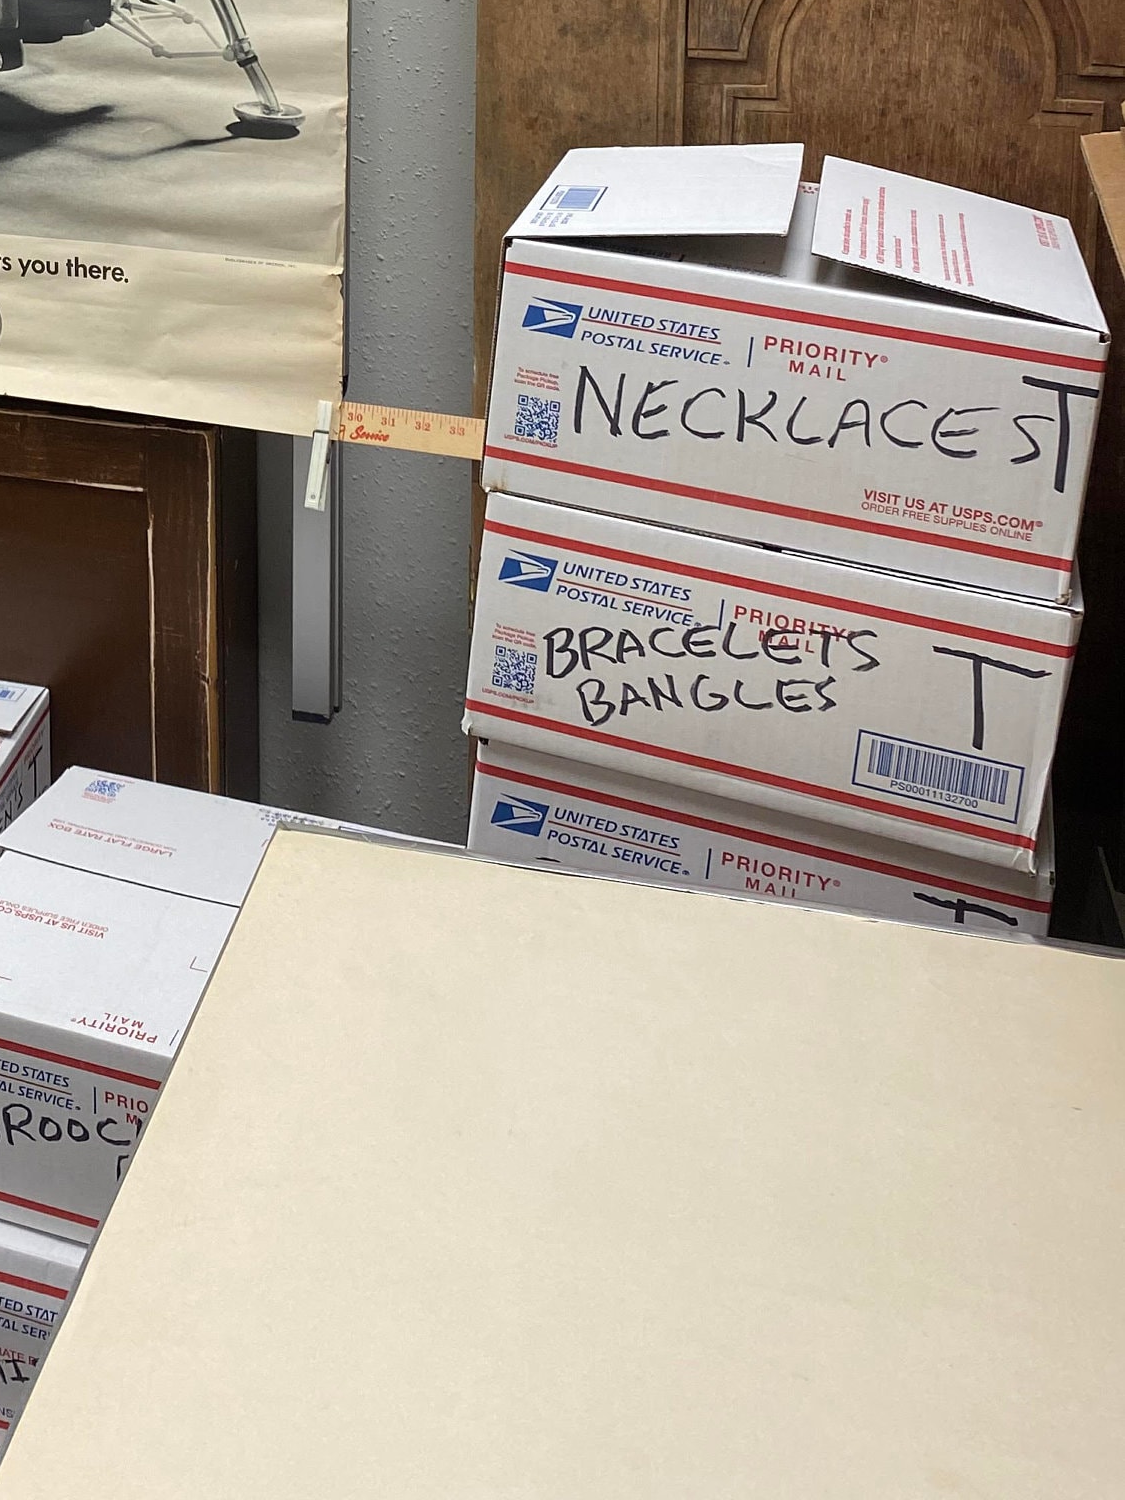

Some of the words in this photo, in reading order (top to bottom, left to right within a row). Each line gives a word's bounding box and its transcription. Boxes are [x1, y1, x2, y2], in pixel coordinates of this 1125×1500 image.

[18, 258, 60, 277] you
[65, 257, 130, 284] there.
[588, 306, 654, 330] UNITED
[658, 318, 721, 340] STATES
[581, 330, 644, 353] POSTAL
[788, 360, 848, 382] MAIL
[347, 411, 363, 423] 30
[381, 417, 395, 427] 31
[415, 421, 431, 431] 32
[449, 426, 465, 436] 33
[574, 366, 1055, 465] NECKLACES
[1022, 376, 1100, 494] T
[864, 489, 901, 506] VISIT
[904, 495, 926, 511] US
[929, 501, 948, 515] AT
[861, 502, 900, 517] ORDER
[902, 509, 931, 523] FREE
[933, 514, 987, 533] SUPPLIES
[990, 527, 1033, 542] ONLINE
[563, 562, 628, 587] UNITED
[631, 576, 692, 601] STATES
[556, 585, 618, 611] POSTAL
[543, 622, 880, 679] BRACELETS
[576, 674, 837, 726] BANGLES
[932, 646, 1053, 751] T
[890, 780, 978, 809] PS00011132700
[47, 821, 73, 834] BOX
[73, 828, 105, 842] RATE
[554, 807, 618, 833] UNITED
[620, 823, 681, 850] STATES
[105, 836, 134, 849] FLAT
[134, 843, 176, 858] LARGE
[547, 829, 608, 855] POSTAL
[45, 917, 60, 927] AT
[61, 922, 76, 932] US
[77, 926, 105, 939] VISIT
[104, 1012, 144, 1029] MAIL
[21, 1066, 70, 1088] STATES
[22, 1324, 51, 1341] SER
